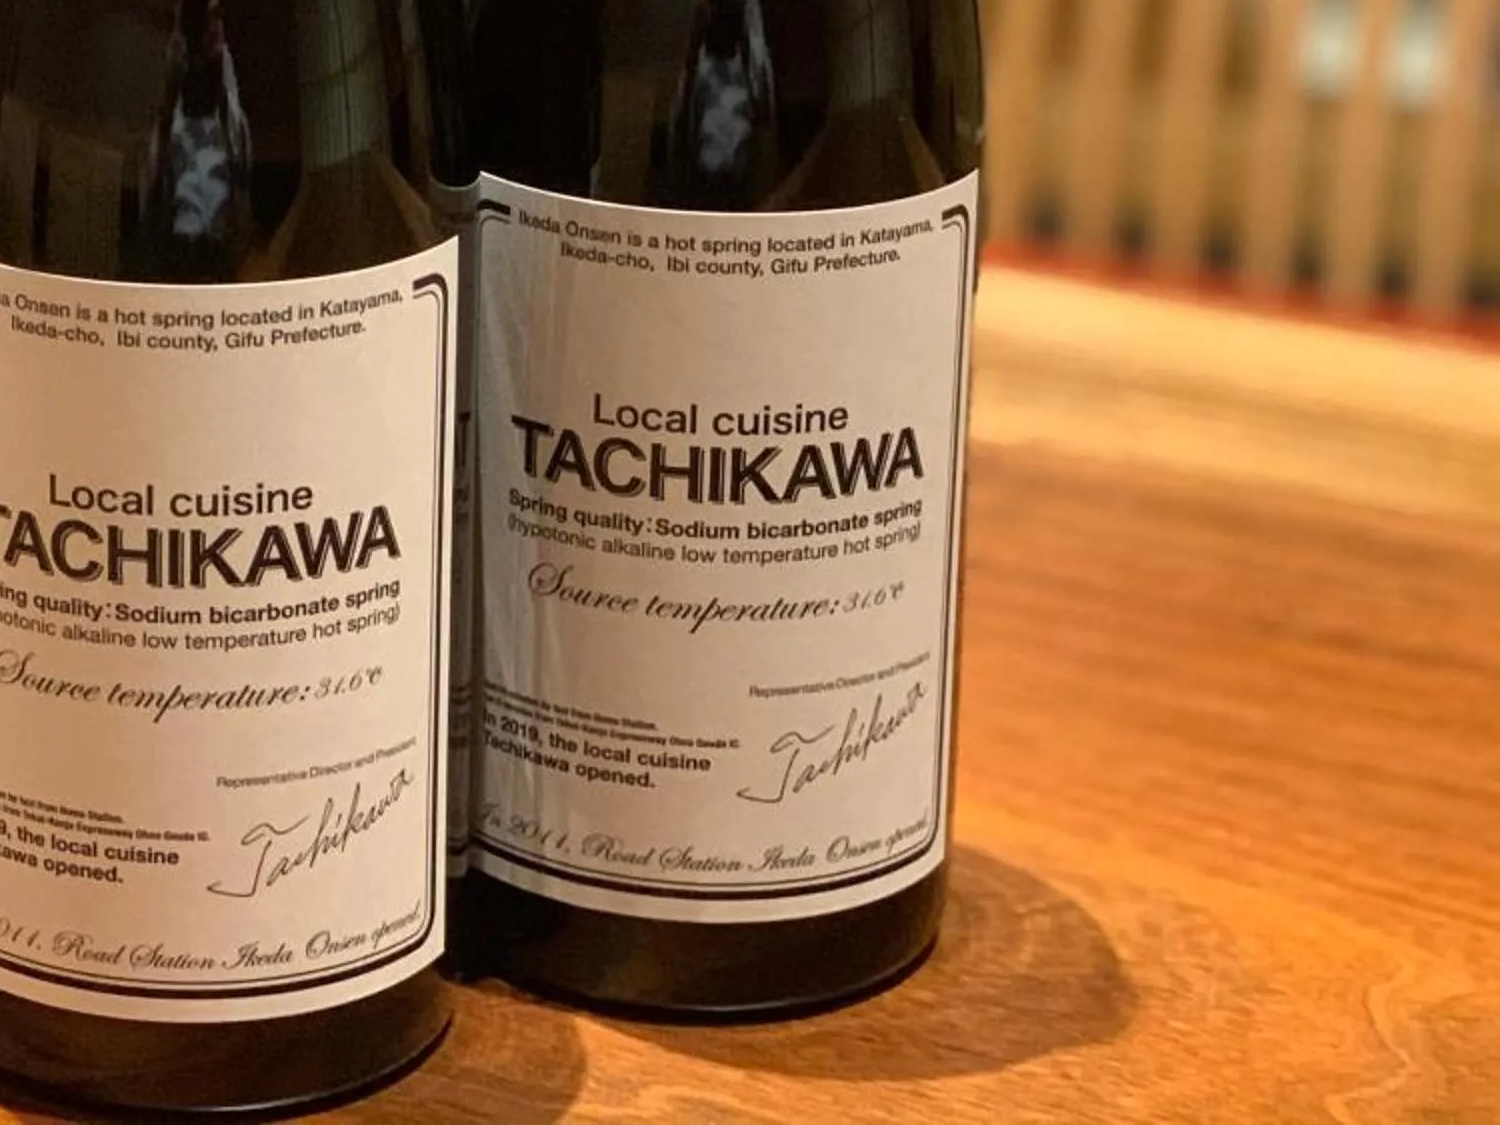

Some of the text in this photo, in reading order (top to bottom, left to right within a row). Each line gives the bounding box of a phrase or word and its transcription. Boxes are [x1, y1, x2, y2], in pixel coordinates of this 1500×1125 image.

[519, 210, 560, 234] Ikeda
[566, 221, 621, 244] Onsen
[627, 231, 643, 247] is
[648, 237, 659, 248] a
[665, 235, 695, 251] hot
[702, 237, 761, 256] spring
[768, 235, 835, 252] located
[841, 232, 855, 247] in
[667, 257, 690, 272] Ibi
[696, 259, 764, 278] county,
[771, 258, 808, 275] Gifu
[814, 249, 900, 272] Prefecture.
[15, 293, 70, 318] Onsen
[76, 302, 91, 321] is
[98, 309, 108, 322] a
[115, 309, 146, 324] hot
[152, 309, 214, 331] spring
[221, 306, 292, 326] located
[299, 304, 314, 320] in
[320, 289, 403, 317] Katayama,
[118, 330, 140, 347] Ibi
[147, 333, 218, 352] county,
[225, 332, 264, 349] Gifu
[271, 320, 366, 345] Prefecture.
[593, 393, 850, 436] Local cuisine
[511, 414, 924, 505] TACHIKAWA
[49, 473, 313, 518] Local cuisine
[508, 488, 567, 522] Spring
[747, 513, 869, 539] bicarbonate
[873, 500, 923, 527] spring
[602, 539, 675, 561] alkaline
[682, 546, 716, 564] low
[723, 544, 838, 567] temperature
[843, 537, 870, 555] hot
[210, 596, 340, 624] bicarbonate
[346, 578, 401, 610] spring
[528, 562, 638, 612] Source
[62, 623, 136, 647] alkaline
[143, 631, 178, 649] low
[185, 627, 307, 652] temperature
[313, 622, 342, 639] hot
[347, 602, 401, 635] spring)
[483, 708, 711, 772] In 2019, the local cuisine
[483, 730, 655, 789] Tachikawa opened.
[17, 826, 45, 847] the
[52, 833, 98, 857] local
[104, 845, 180, 864] cuisine
[581, 833, 655, 865] Road
[658, 844, 742, 872] Station
[43, 857, 123, 884] opened.
[52, 931, 127, 965] Road
[129, 942, 213, 969] Station
[222, 941, 293, 969] Ikeda
[306, 930, 366, 959] Onsen
